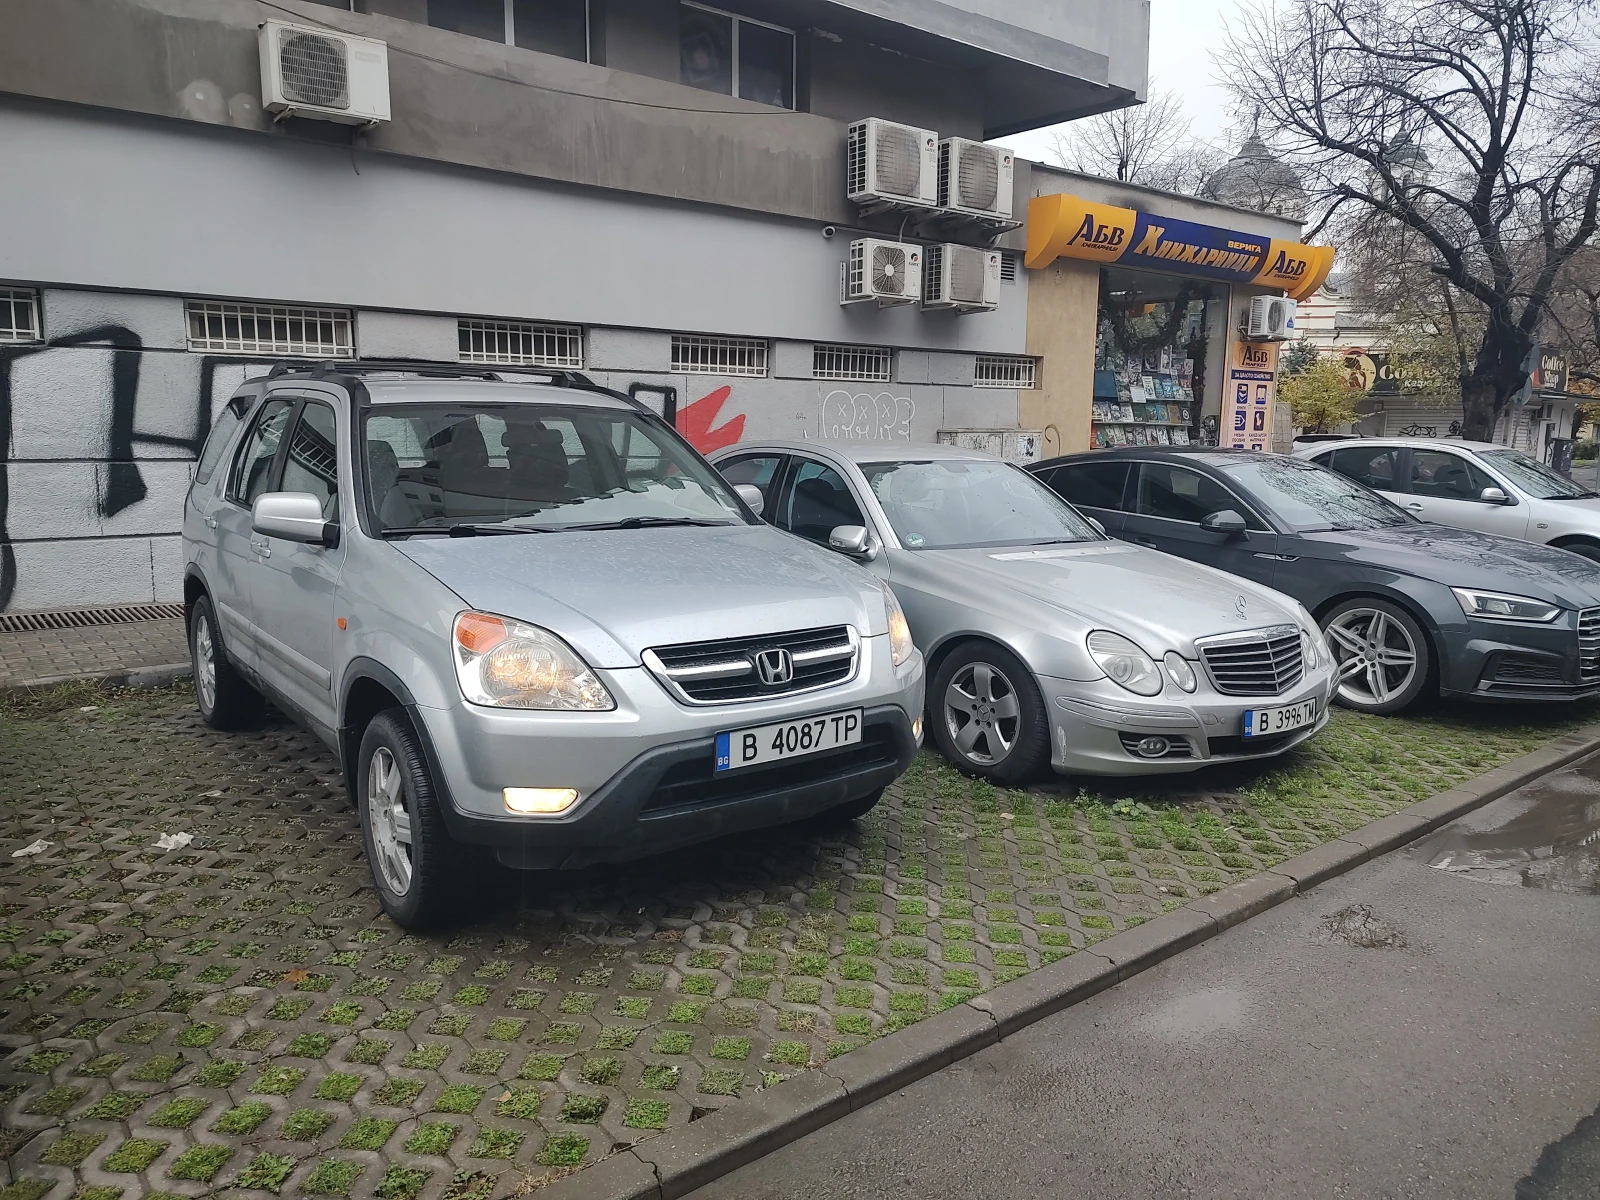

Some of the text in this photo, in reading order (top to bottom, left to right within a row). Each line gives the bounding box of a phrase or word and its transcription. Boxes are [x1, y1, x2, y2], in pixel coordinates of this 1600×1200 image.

[1066, 213, 1125, 246] АБВ
[1227, 241, 1262, 254] ВЕРИГА
[1263, 250, 1307, 277] АБВ
[1241, 345, 1268, 366] АБВ
[1541, 354, 1565, 371] Coffee
[1260, 713, 1269, 732] B
[1276, 706, 1302, 729] 3996
[742, 714, 858, 762] B 4087 TP
[717, 756, 729, 766] BG
